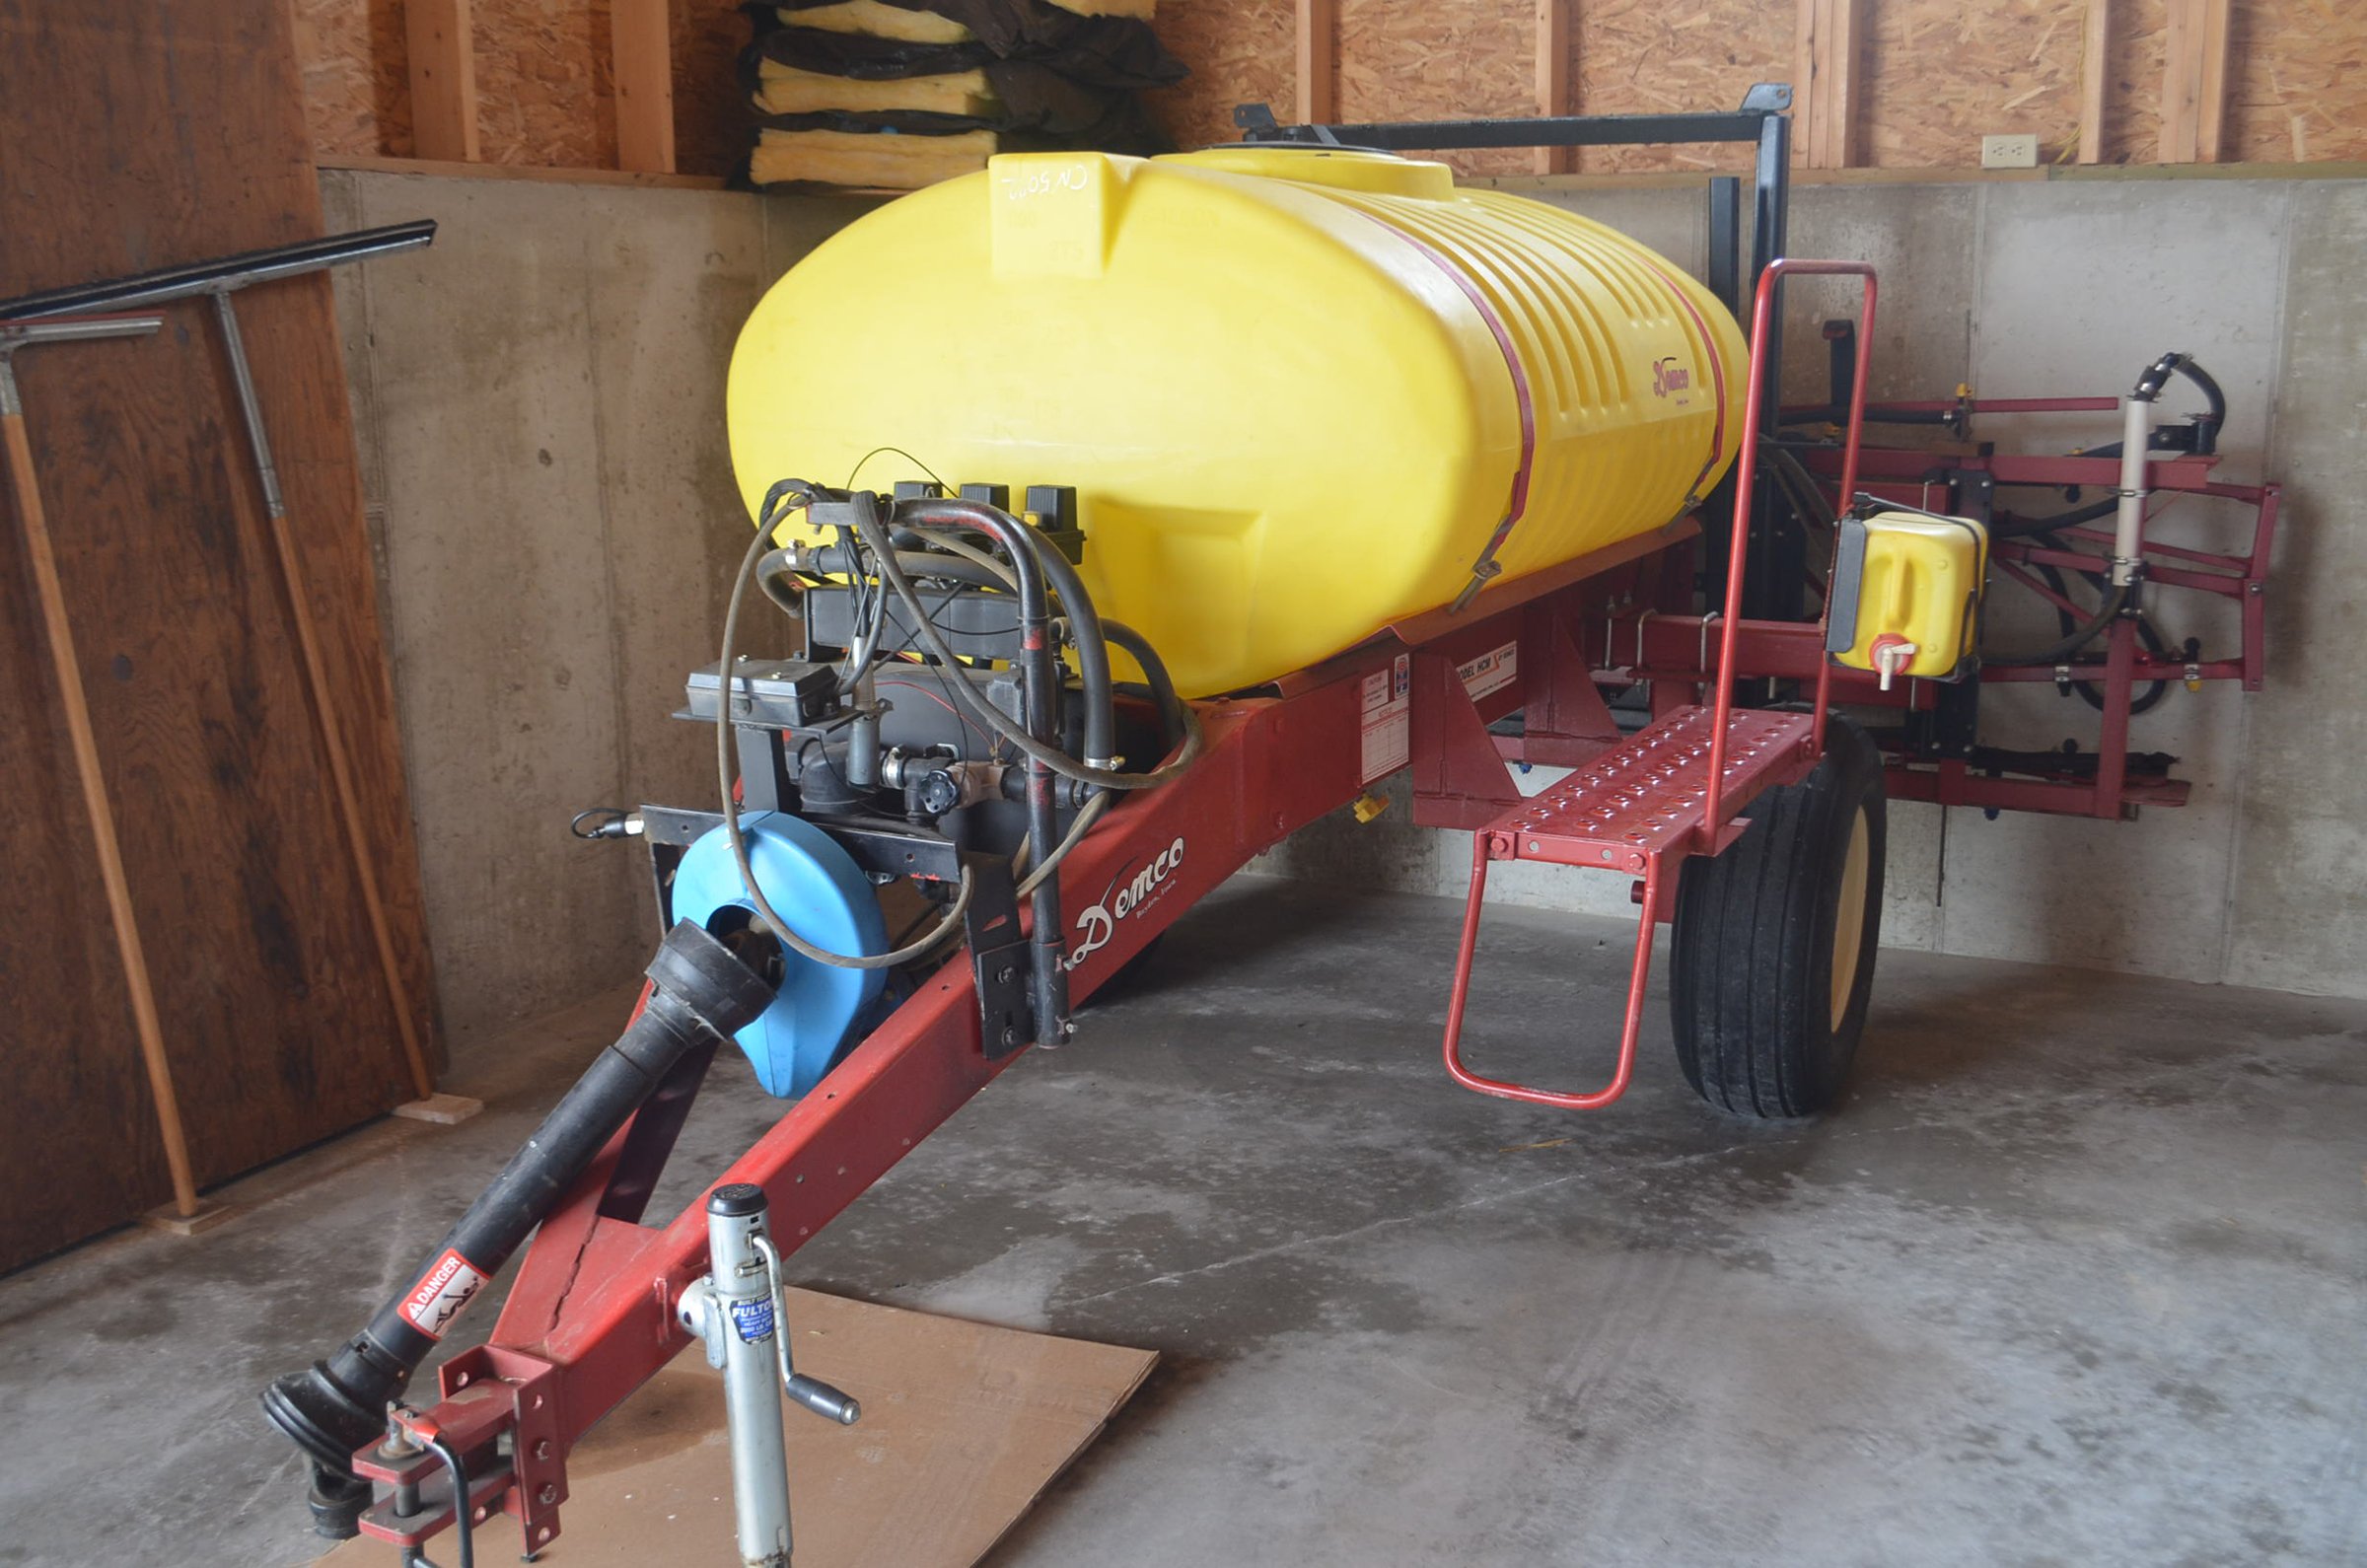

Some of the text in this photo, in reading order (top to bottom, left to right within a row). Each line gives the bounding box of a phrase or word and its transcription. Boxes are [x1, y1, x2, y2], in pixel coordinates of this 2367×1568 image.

[1460, 666, 1475, 680] ODEL
[1062, 836, 1184, 971] Demco
[416, 1256, 462, 1305] DANGER
[732, 1299, 772, 1319] FULTO
